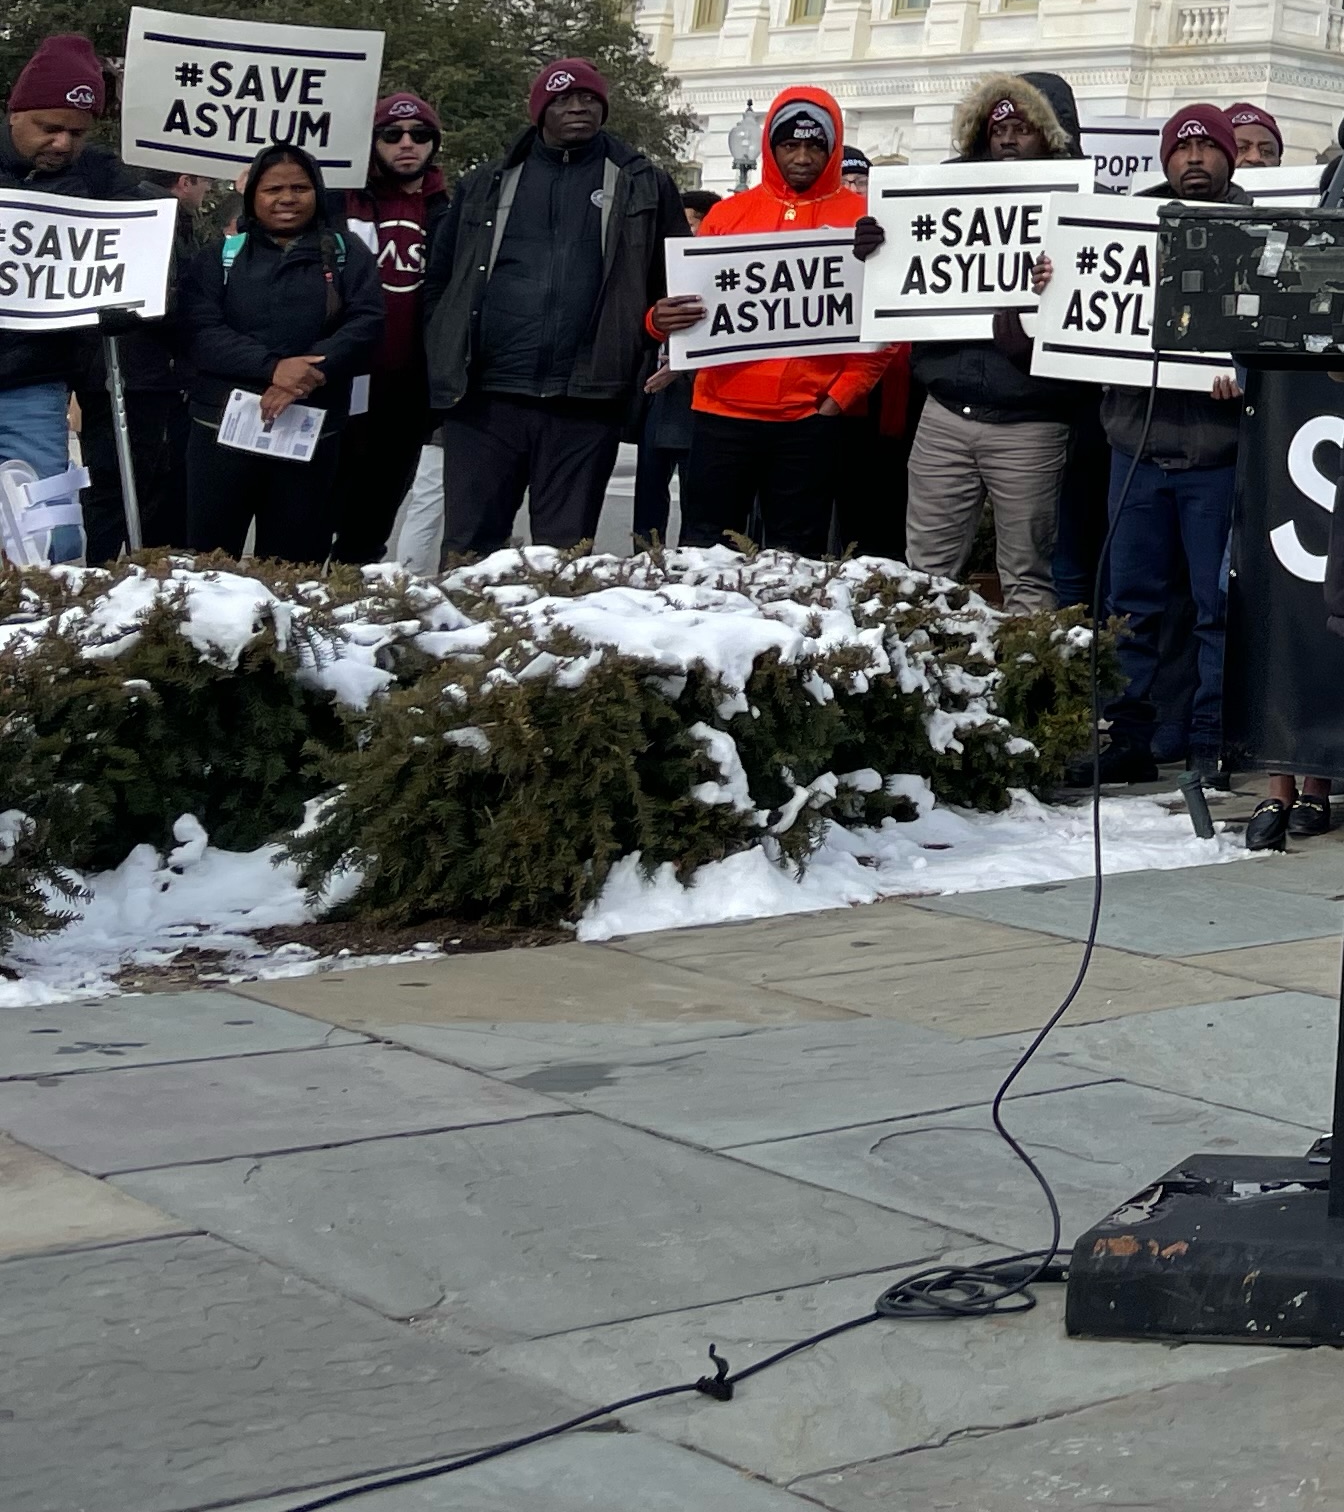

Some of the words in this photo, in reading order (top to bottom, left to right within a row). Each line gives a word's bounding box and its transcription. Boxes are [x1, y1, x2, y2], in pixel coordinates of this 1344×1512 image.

[65, 86, 95, 109] CAS
[174, 61, 327, 106] #SAVE
[162, 99, 332, 147] ASYLUM
[1094, 155, 1154, 178] PORT
[0, 221, 121, 262] SAVE
[910, 204, 1043, 248] #SAVE
[0, 261, 126, 300] SYLUM
[714, 255, 845, 295] #SAVE
[1075, 242, 1151, 288] #SA
[709, 292, 854, 337] ASYLUM
[1061, 289, 1151, 337] ASYL
